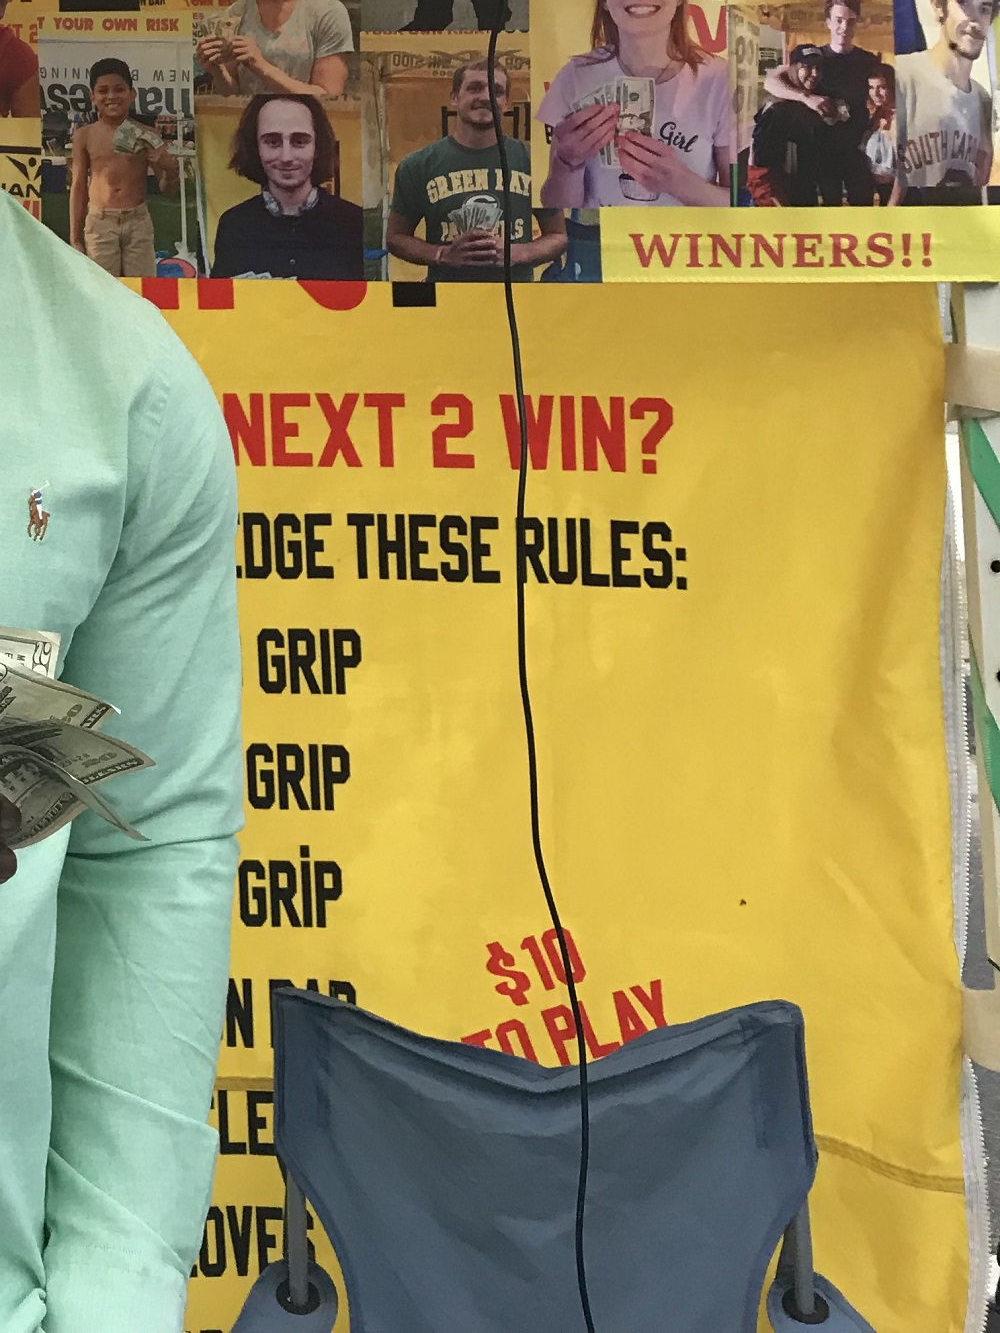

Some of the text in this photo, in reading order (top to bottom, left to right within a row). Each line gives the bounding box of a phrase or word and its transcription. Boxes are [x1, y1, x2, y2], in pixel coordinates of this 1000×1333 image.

[53, 17, 94, 31] YOUR
[102, 18, 137, 31] OWN
[146, 18, 180, 31] RISK
[659, 121, 699, 154] Girl
[426, 169, 488, 204] GREEN
[628, 232, 934, 269] WINNERS!!
[223, 393, 674, 475] NEXT 2 WIN?
[347, 513, 501, 584] THESE
[516, 517, 688, 591] RULES:
[256, 628, 362, 695] GRIP
[245, 743, 351, 811] GRIP
[485, 927, 587, 1006] $10
[540, 978, 670, 1065] PLAY
